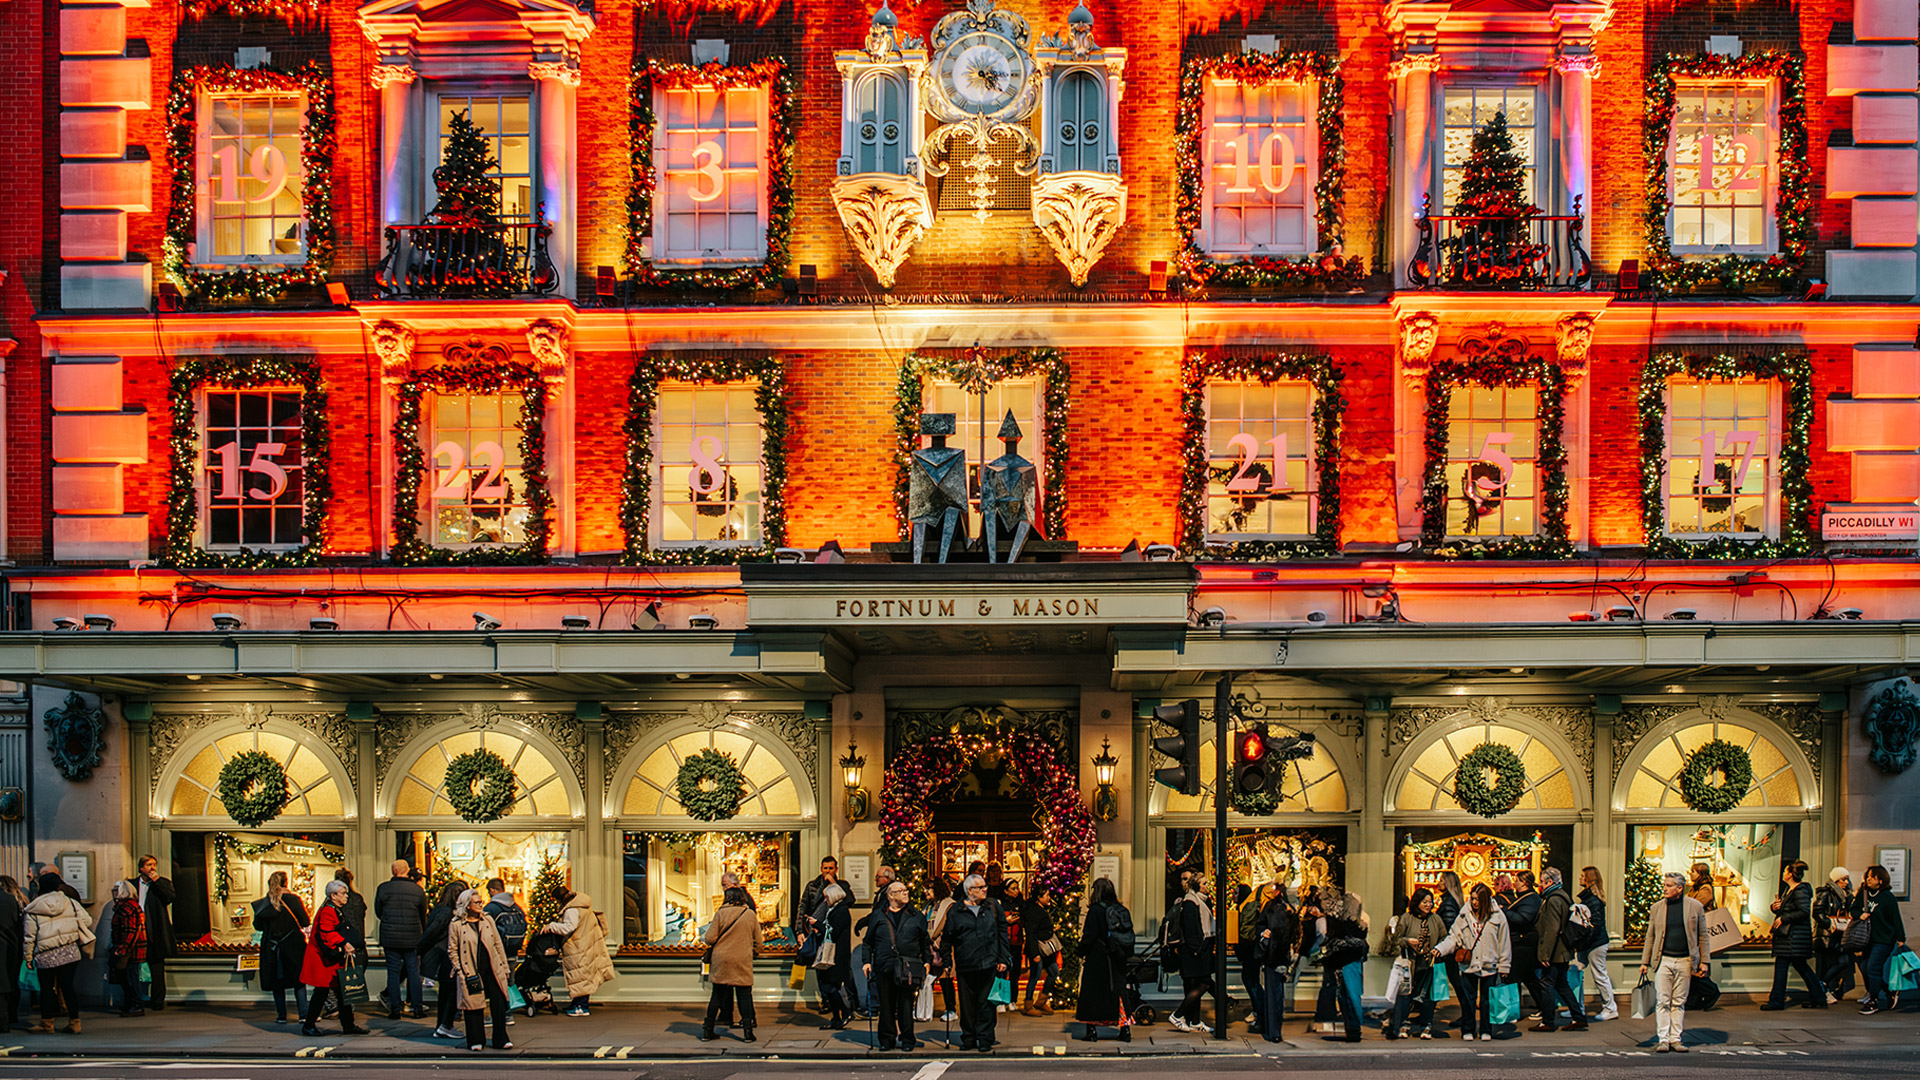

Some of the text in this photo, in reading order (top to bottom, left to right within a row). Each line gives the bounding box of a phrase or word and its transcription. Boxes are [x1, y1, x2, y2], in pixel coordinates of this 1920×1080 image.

[212, 144, 289, 205] 19
[687, 141, 724, 202] 3
[1225, 132, 1294, 195] 10
[1694, 134, 1762, 192] 12
[213, 442, 289, 501] 15
[432, 441, 510, 500] 22
[688, 435, 725, 493] 8
[1226, 432, 1290, 492] 21
[1477, 432, 1515, 490] 5
[1691, 431, 1760, 489] 17
[1828, 517, 1914, 528] PICCADILLY W1
[836, 598, 1099, 617] FORTNUM & MASON
[287, 846, 314, 856] LIFT
